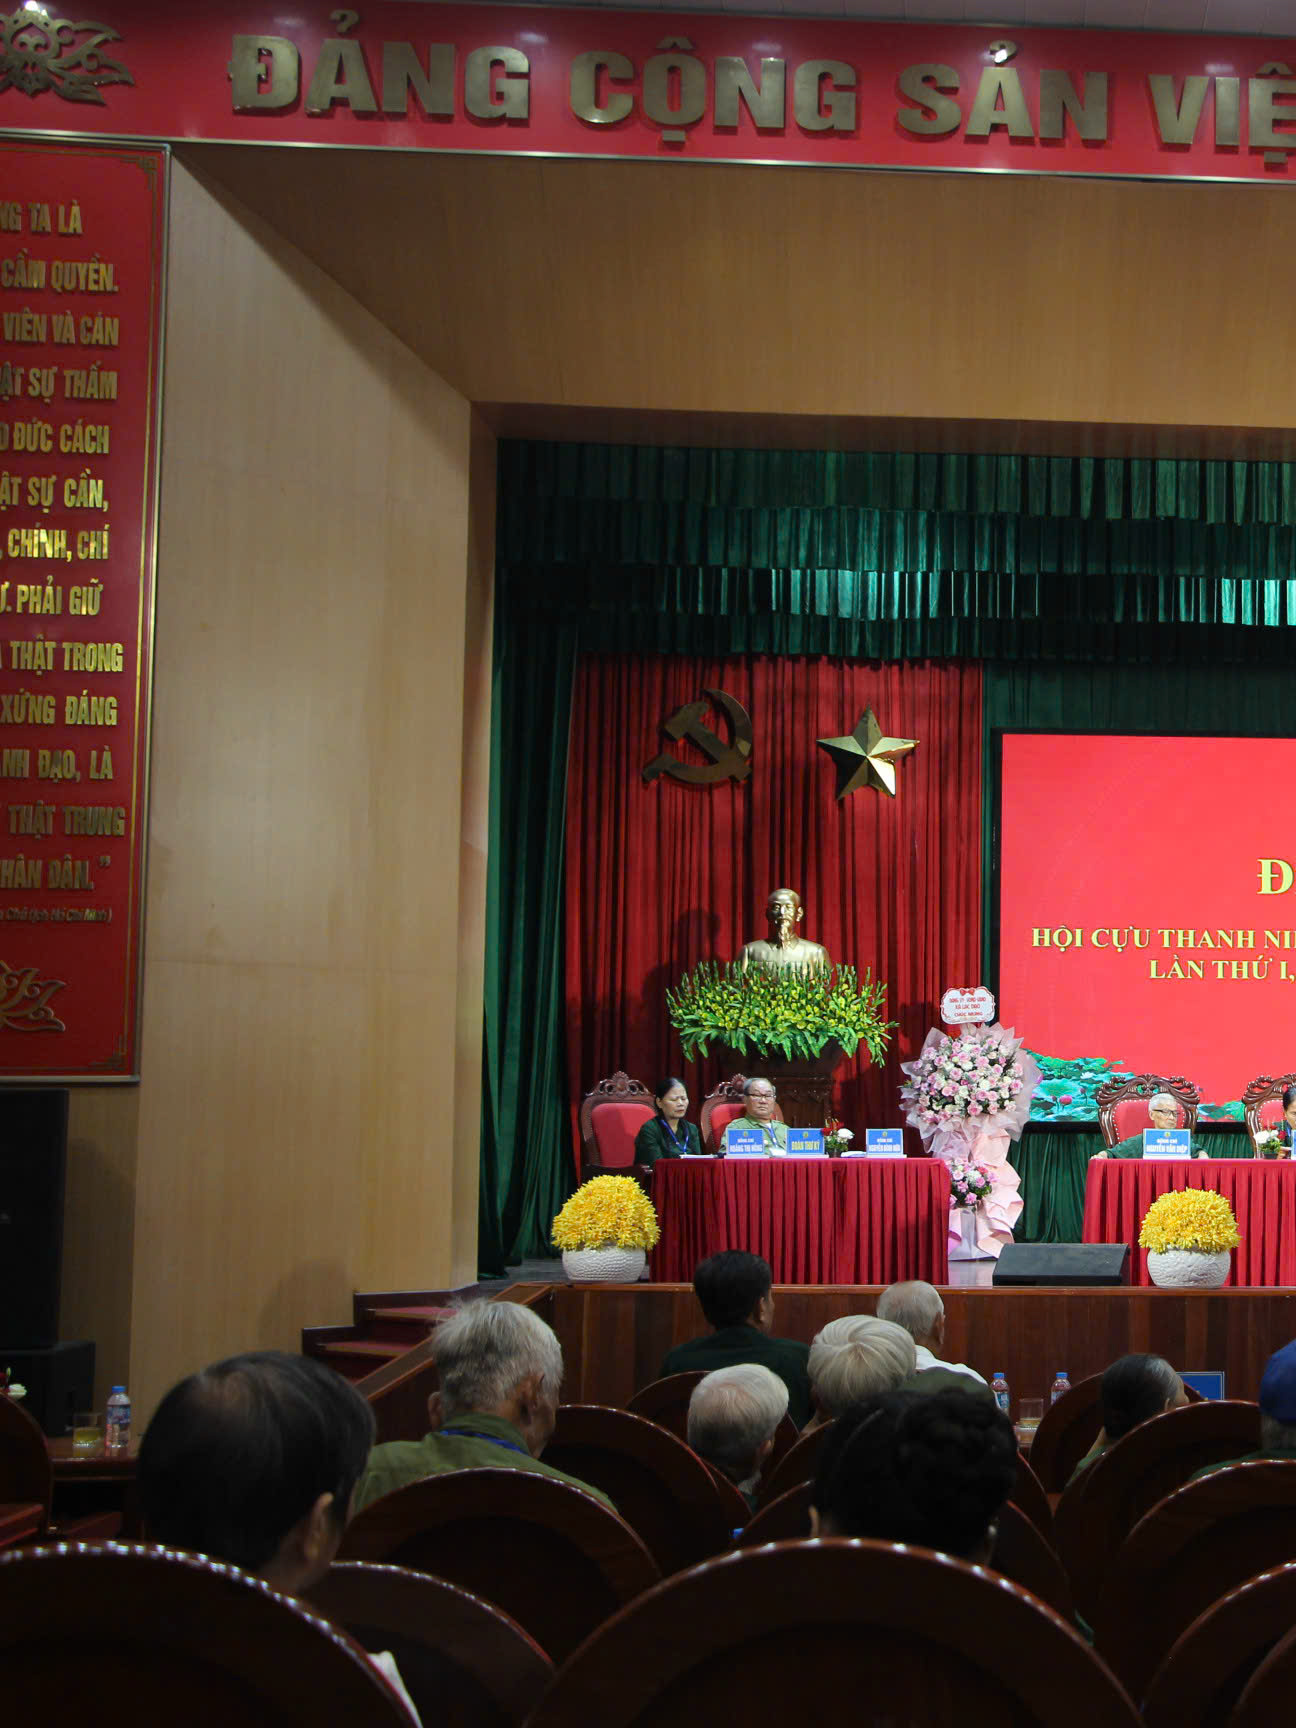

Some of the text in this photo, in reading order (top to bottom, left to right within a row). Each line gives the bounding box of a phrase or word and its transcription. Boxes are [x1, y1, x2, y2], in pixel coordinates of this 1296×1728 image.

[228, 10, 530, 121] ĐẢNG
[569, 37, 857, 143] CỘNG
[896, 40, 1108, 141] SẢN
[28, 202, 51, 233] TA
[58, 200, 83, 234] LÀ
[3, 307, 47, 343] VIÊN
[52, 310, 76, 344] VÀ
[0, 361, 24, 402] ẬT
[28, 367, 58, 404] SỰ
[13, 417, 53, 453] ĐỨC
[59, 419, 110, 454] CÁCH
[27, 475, 56, 513] SỰ
[64, 468, 109, 512] CẦN,
[8, 522, 110, 562] CHÍNH, CHÍ
[16, 575, 62, 614] PHẢI
[69, 578, 104, 616] GIỮ
[10, 634, 124, 676] THẬT TRONG
[1, 688, 118, 726] XỨNG ĐÁNG
[38, 750, 81, 783] ĐẠO,
[89, 745, 114, 780] LÀ
[8, 800, 126, 840] THẬT TRUNG
[1031, 925, 1083, 953] HỘI
[1091, 926, 1151, 953] CỰU
[1158, 929, 1256, 949] THANH
[1149, 954, 1205, 980] LẦN
[1211, 955, 1273, 980] THỨ
[1280, 960, 1296, 983] I,
